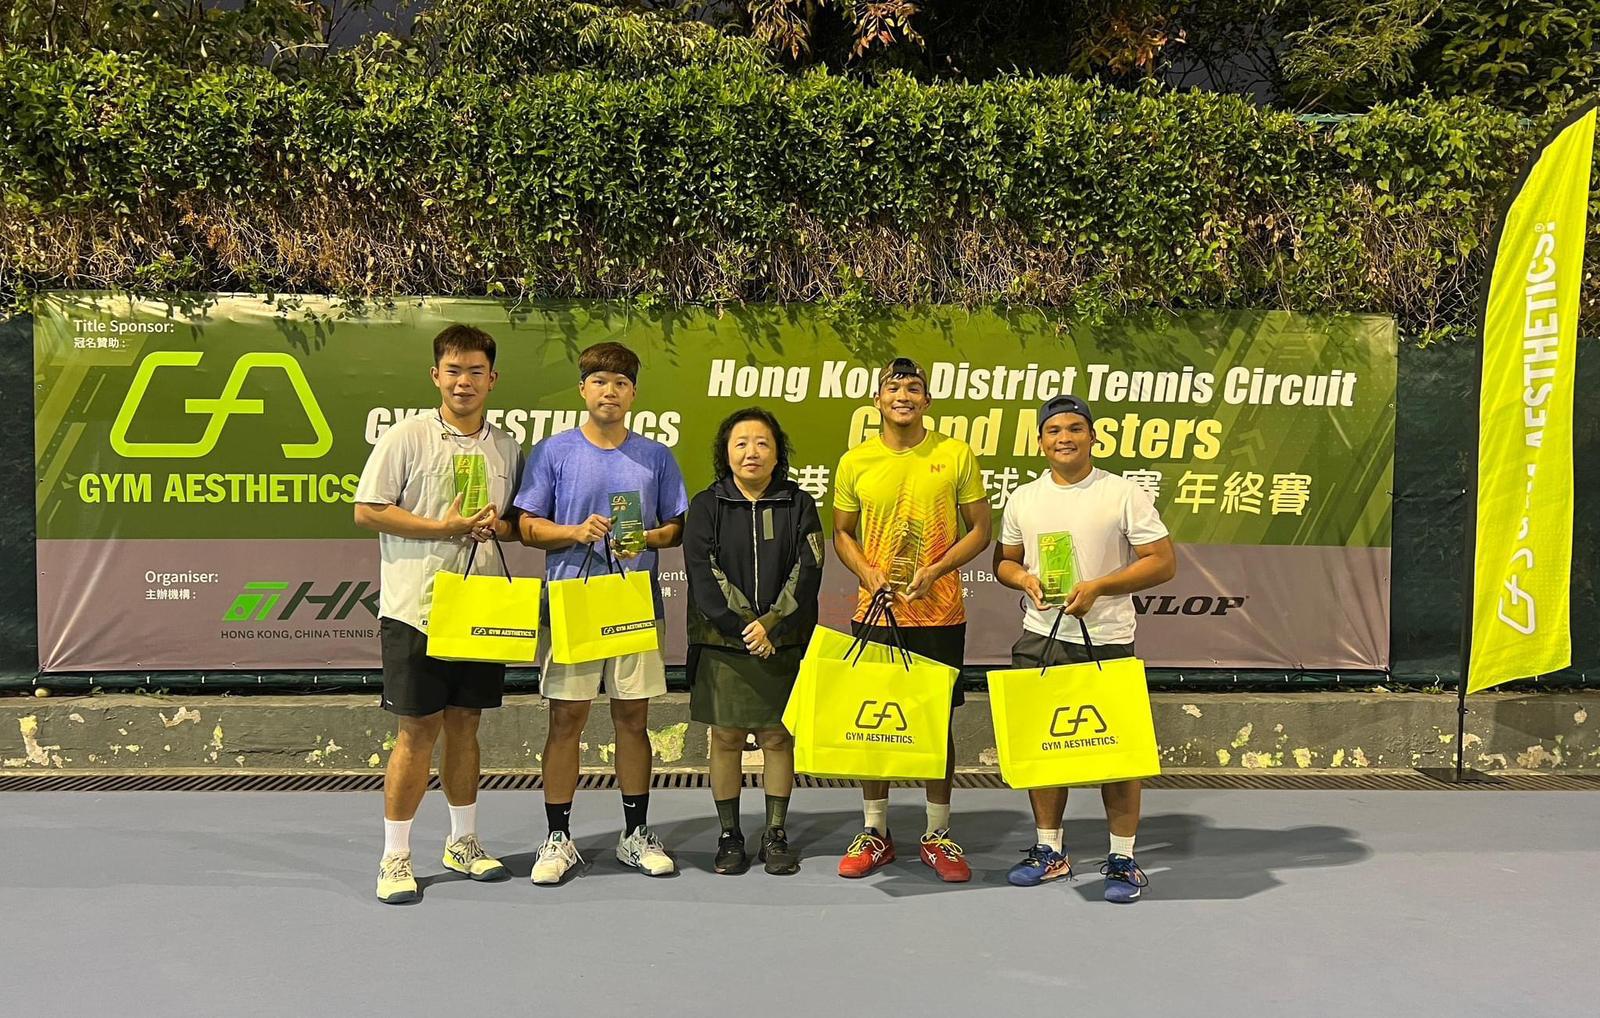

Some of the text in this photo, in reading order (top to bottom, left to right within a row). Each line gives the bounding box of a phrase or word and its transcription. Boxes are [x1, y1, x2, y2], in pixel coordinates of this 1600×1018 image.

[73, 319, 174, 335] Title Sponsor:
[707, 359, 1357, 407] Hong Kon District Tennis Circuit
[1012, 408, 1223, 460] Msters
[78, 473, 359, 504] GYM AESTHETICS
[1174, 470, 1312, 515] 年終賽
[145, 570, 219, 586] Organiser:
[1131, 595, 1246, 616] NLOP
[220, 629, 255, 640] HONG
[257, 629, 293, 641] KONG,
[295, 629, 331, 639] CHINA
[332, 629, 374, 639] TENNIS
[845, 732, 864, 741] GYM
[1042, 741, 1061, 751] GYM
